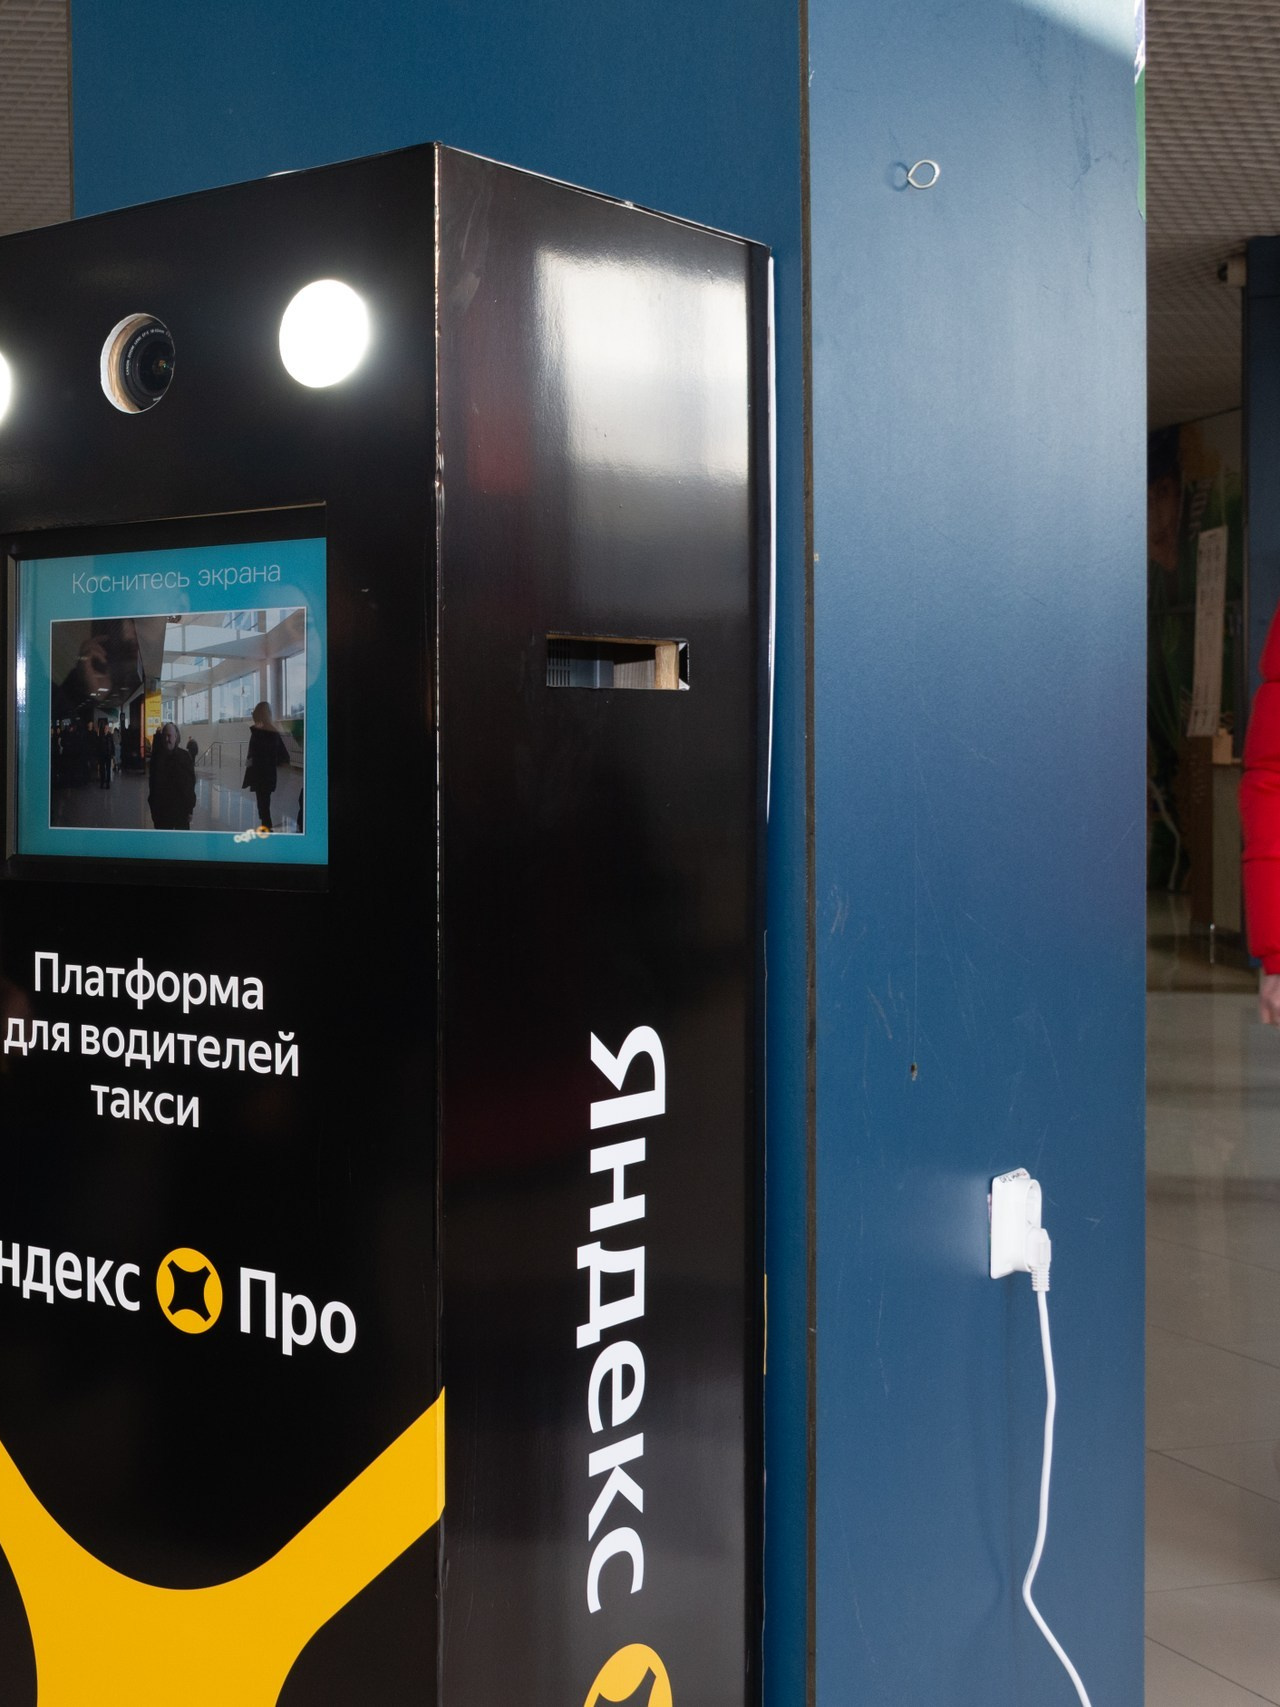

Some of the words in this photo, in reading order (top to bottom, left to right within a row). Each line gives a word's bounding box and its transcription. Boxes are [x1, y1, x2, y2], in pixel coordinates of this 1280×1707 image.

[72, 570, 190, 594] Коснитесь
[197, 564, 282, 591] экрана
[34, 950, 265, 1014] Платформа
[4, 1017, 70, 1056] для
[80, 1030, 299, 1077] водителей
[90, 1084, 200, 1128] такси
[239, 1266, 357, 1356] Про
[576, 1025, 666, 1613] Яндекс
